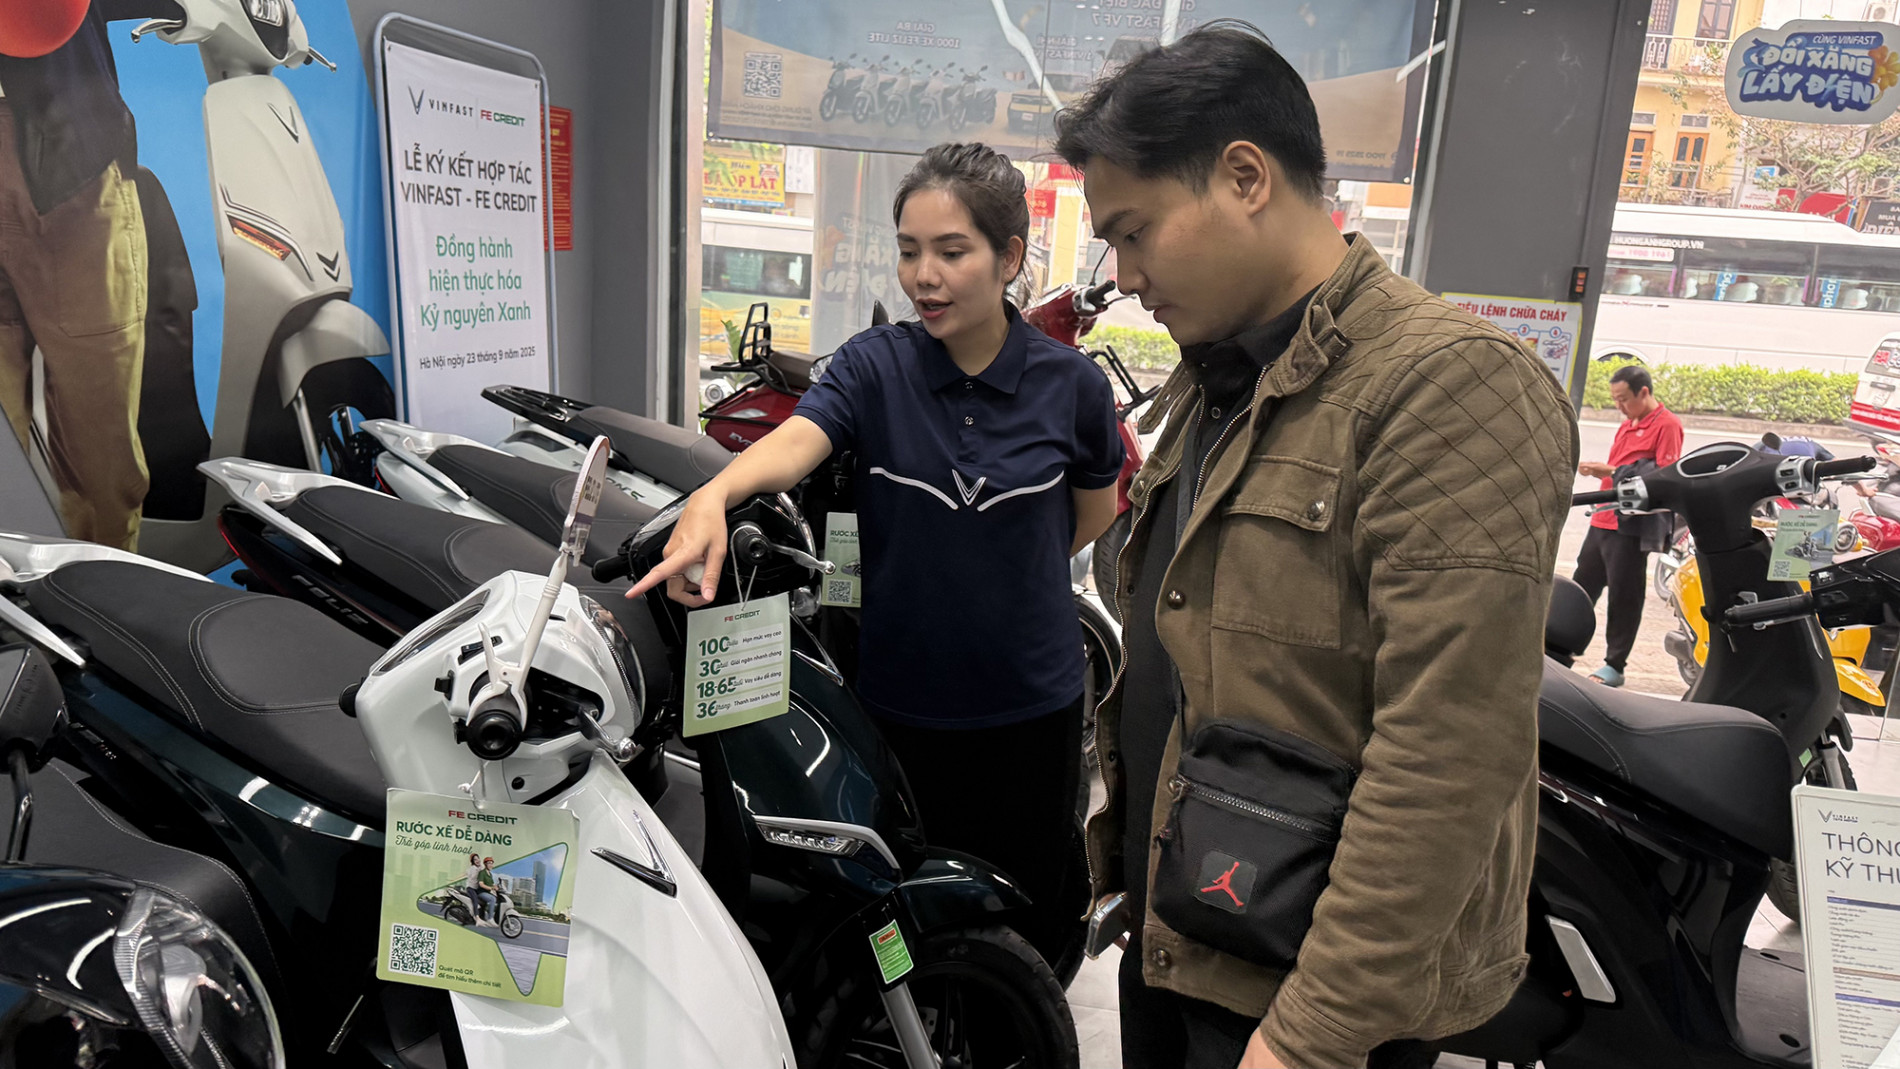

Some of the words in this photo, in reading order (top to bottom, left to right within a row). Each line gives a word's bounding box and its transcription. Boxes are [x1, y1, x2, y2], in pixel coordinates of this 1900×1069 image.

[1813, 34, 1836, 45] CÙNG
[1838, 35, 1877, 45] VINFAST
[1807, 45, 1873, 76] XĂNG
[1743, 65, 1803, 95] LẤY
[1805, 73, 1873, 104] ĐIỆN
[429, 99, 473, 117] VINFAST
[481, 109, 492, 121] FE
[493, 112, 525, 127] CREDIT
[404, 142, 422, 172] LỄ
[426, 149, 444, 174] KÝ
[449, 151, 474, 178] KẾT
[478, 160, 506, 186] HỢP
[509, 161, 532, 185] TÁC
[401, 181, 462, 207] VINFAST
[475, 190, 490, 209] FE
[494, 192, 537, 213] CREDIT
[436, 233, 475, 263] Đồng
[479, 236, 513, 258] hành
[429, 268, 460, 296] hiện
[463, 269, 495, 296] thực
[497, 269, 522, 290] hóa
[420, 302, 440, 332] Kỷ
[444, 301, 495, 330] nguyên
[497, 300, 531, 321] Xanh
[1481, 302, 1507, 318] LỆNH
[1509, 305, 1537, 320] CHỮA
[1540, 308, 1567, 322] CHÁY
[420, 358, 431, 369] Hà
[433, 355, 446, 370] Nội
[447, 354, 466, 369] ngày
[467, 352, 476, 364] 23
[477, 350, 498, 363] tháng
[498, 349, 503, 360] 9
[504, 348, 519, 359] năm
[520, 346, 536, 358] 2025
[734, 609, 760, 620] CREDIT
[699, 636, 730, 656] 100
[699, 658, 721, 677] 30
[448, 810, 465, 819] FE
[467, 812, 518, 825] CREDIT
[395, 834, 413, 847] Trả
[414, 839, 431, 850] góp
[433, 841, 451, 852] linh
[451, 846, 473, 855] hoạt
[396, 821, 433, 836] RƯỚC
[436, 824, 454, 838] XẾ
[455, 825, 472, 841] DỄ
[475, 830, 512, 846] DÀNG
[1826, 856, 1855, 879] KỸ
[1860, 863, 1900, 884] TH
